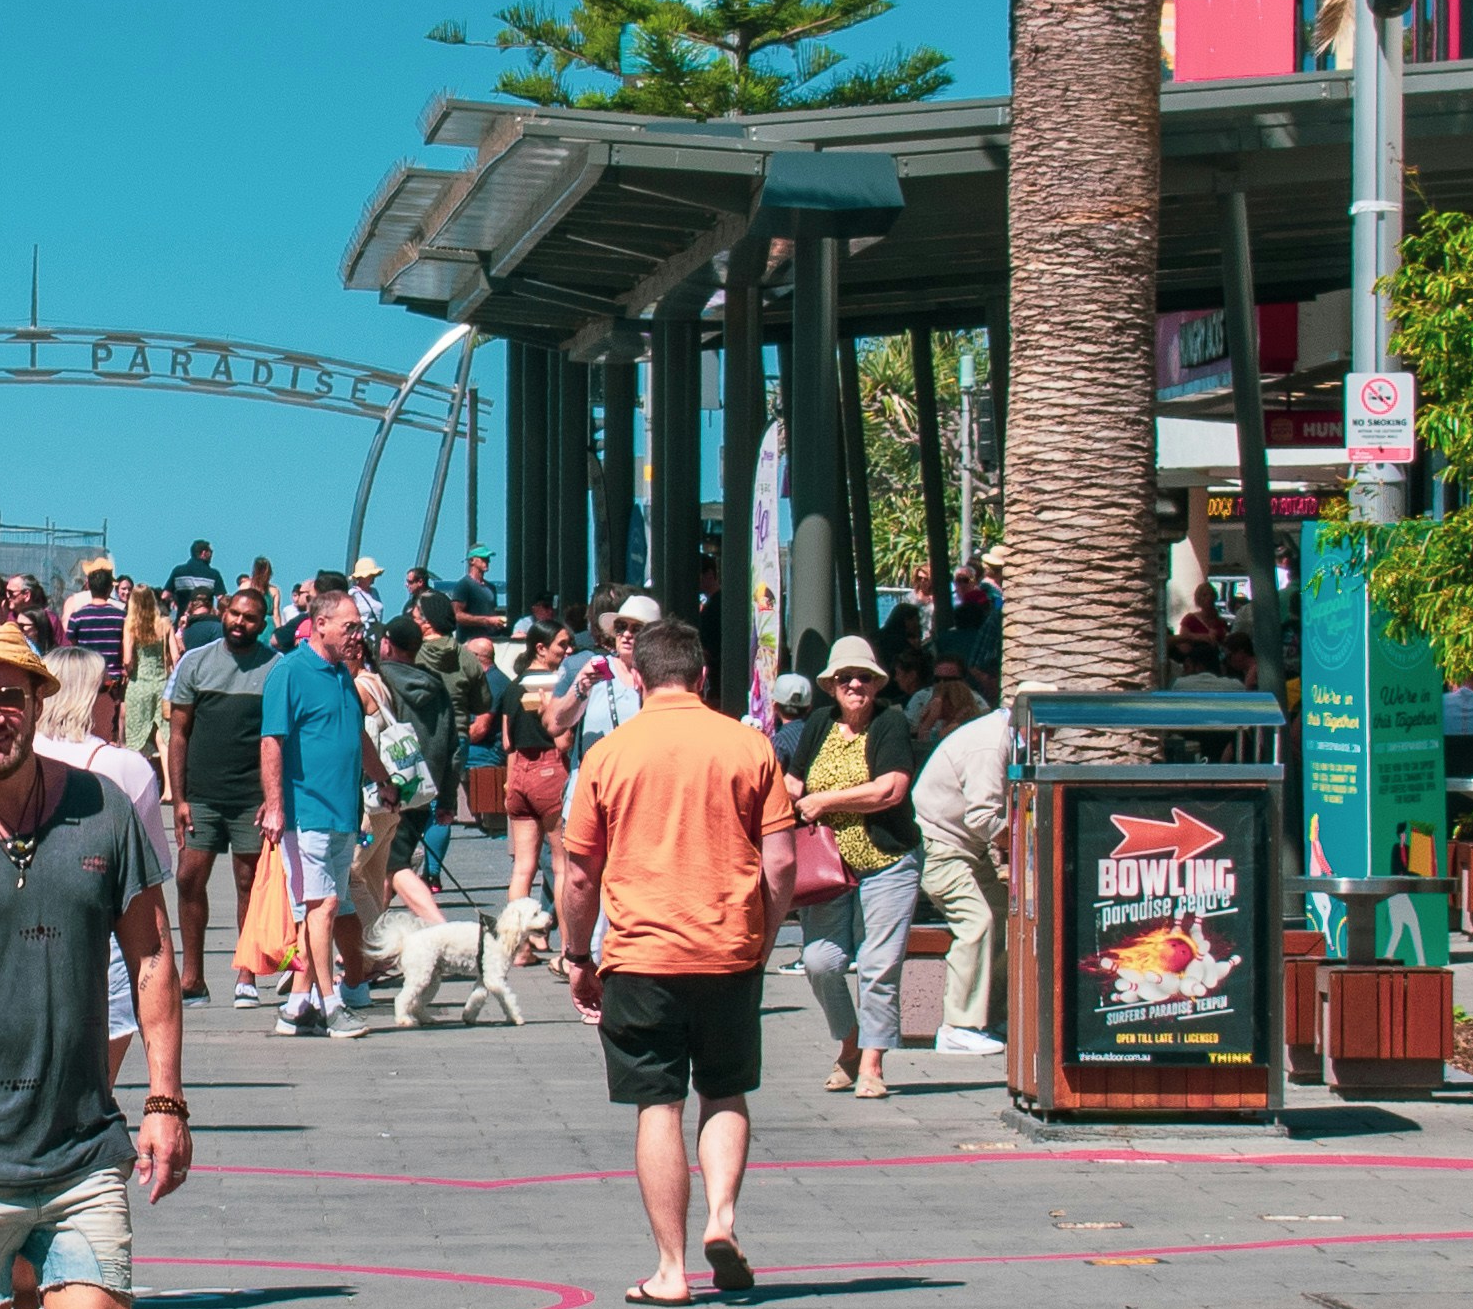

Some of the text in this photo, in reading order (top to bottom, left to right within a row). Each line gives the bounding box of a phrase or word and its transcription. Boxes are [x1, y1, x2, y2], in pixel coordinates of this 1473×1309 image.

[92, 342, 373, 402] PARADISE
[1352, 419, 1407, 427] NO SMOKING
[1311, 684, 1341, 705] We're
[1380, 685, 1417, 707] We're
[1097, 859, 1236, 897] BOWLING
[1101, 893, 1173, 932] paradise
[1106, 1006, 1147, 1026] SURFERS
[1149, 998, 1193, 1019] PARADISE
[1116, 1033, 1219, 1043] OPEN TILL LATE LICENSED
[1208, 1052, 1253, 1063] THINK
